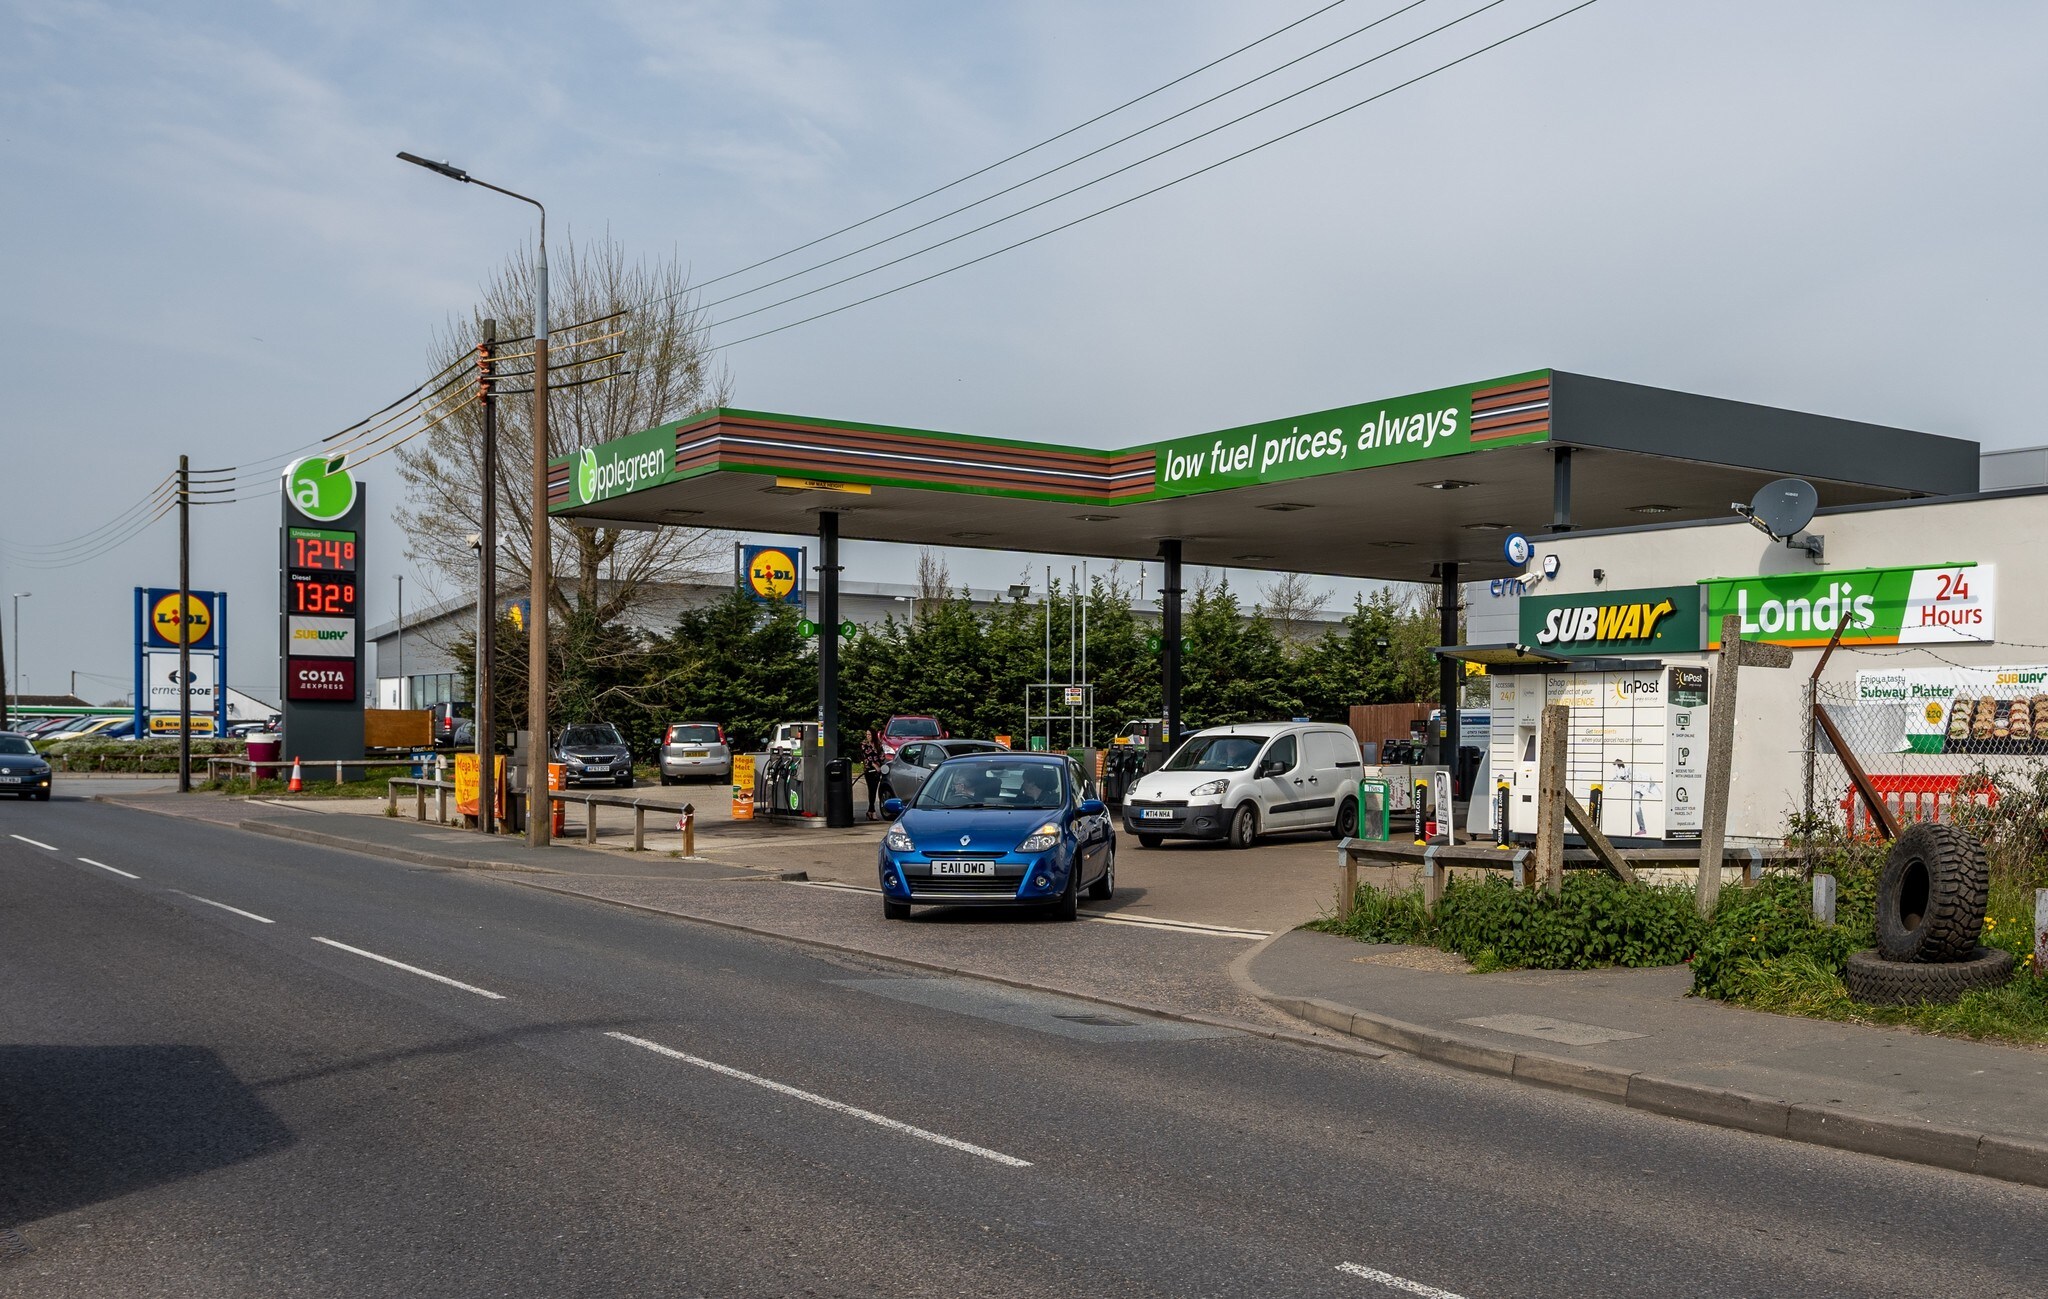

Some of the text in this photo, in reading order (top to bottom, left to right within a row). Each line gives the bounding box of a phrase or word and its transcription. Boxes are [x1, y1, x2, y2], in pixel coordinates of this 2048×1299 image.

[1164, 407, 1459, 482] low fuel prices, always
[588, 448, 665, 501] applegreen
[292, 530, 321, 538] Unleaded
[1936, 574, 1968, 601] 24
[1738, 582, 1875, 634] Londis
[1922, 604, 1982, 627] Hours
[1536, 599, 1675, 645] SUBWAY
[293, 629, 348, 640] SUBWAY
[803, 624, 809, 635] 1
[845, 625, 852, 636] 2
[1151, 640, 1158, 650] 3
[1184, 642, 1191, 651] 4
[299, 670, 345, 682] COSTA
[1684, 673, 1702, 683] InPost
[1861, 676, 1881, 684] Enjoy
[1887, 676, 1906, 684] tasty
[1995, 673, 2047, 684] SUBWAY
[1549, 678, 1565, 687] Shop
[1623, 680, 1659, 694] InPost
[1861, 685, 1955, 699] Subway Platter
[965, 862, 986, 874] OWO
